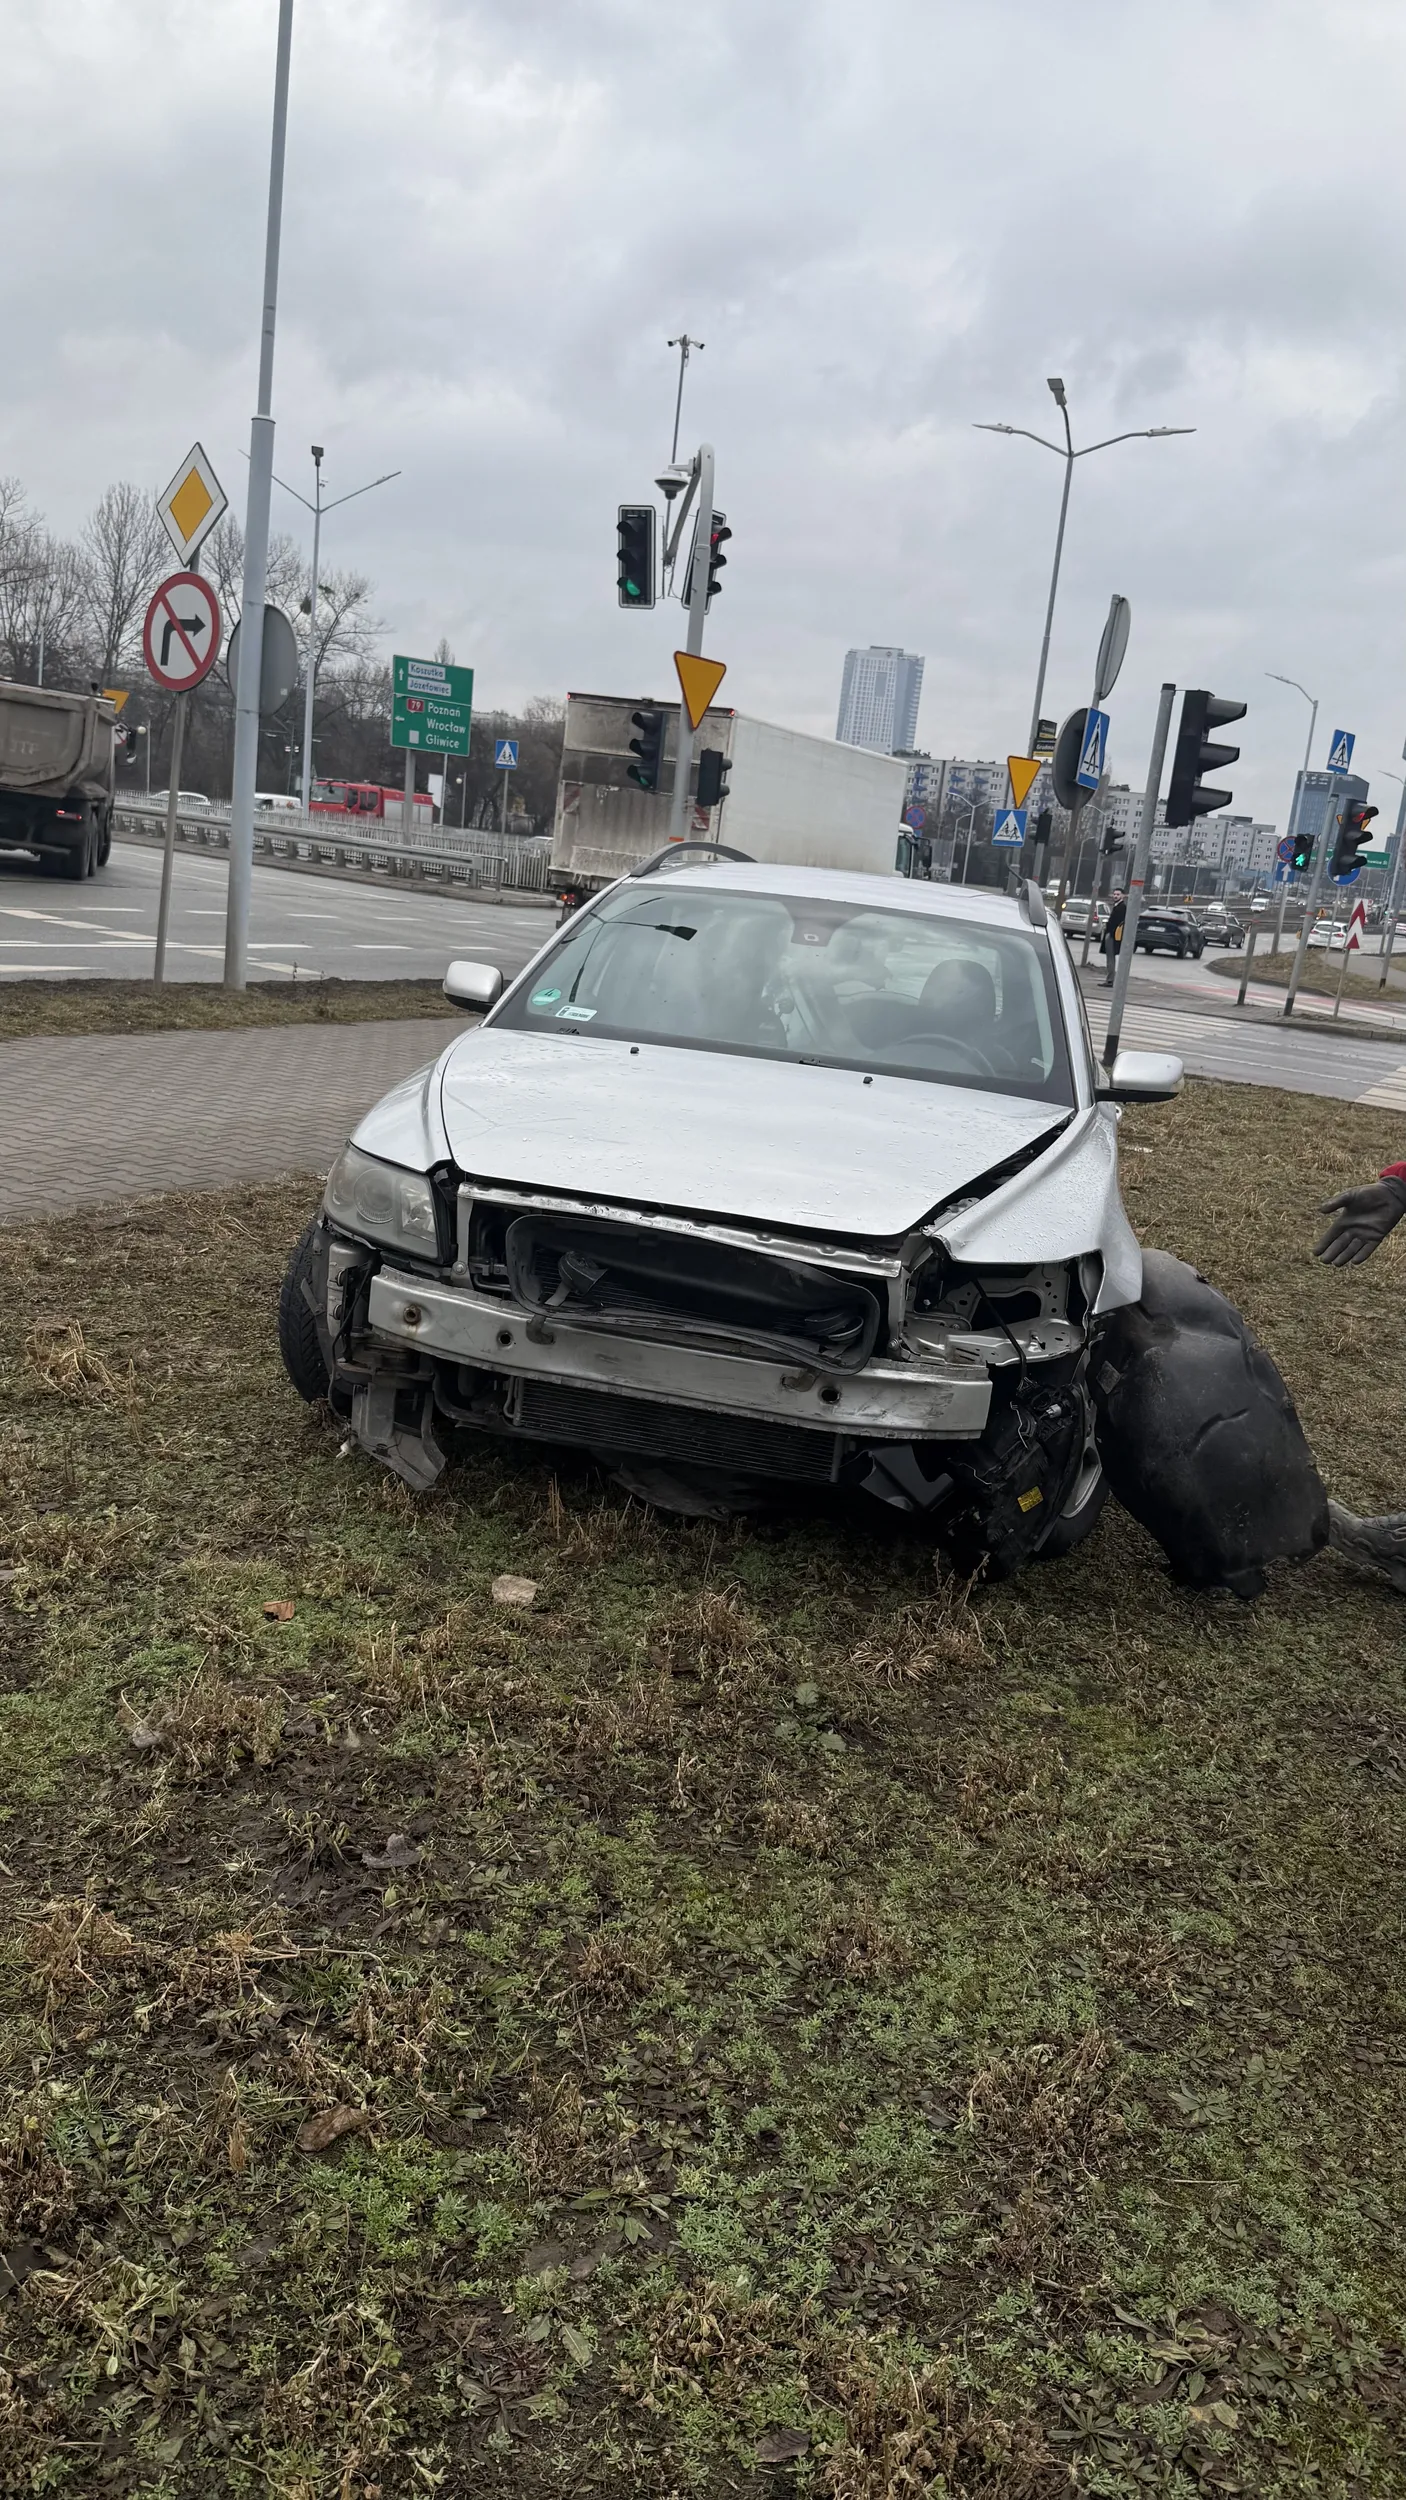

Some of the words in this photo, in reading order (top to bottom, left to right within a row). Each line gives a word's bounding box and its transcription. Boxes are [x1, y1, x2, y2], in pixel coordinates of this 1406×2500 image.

[409, 664, 444, 678] Koszutka
[409, 680, 450, 694] Józefowiec
[411, 700, 421, 710] 79
[427, 702, 461, 717] Poznań
[426, 718, 466, 734] Wrocław
[425, 733, 460, 749] Gliwice
